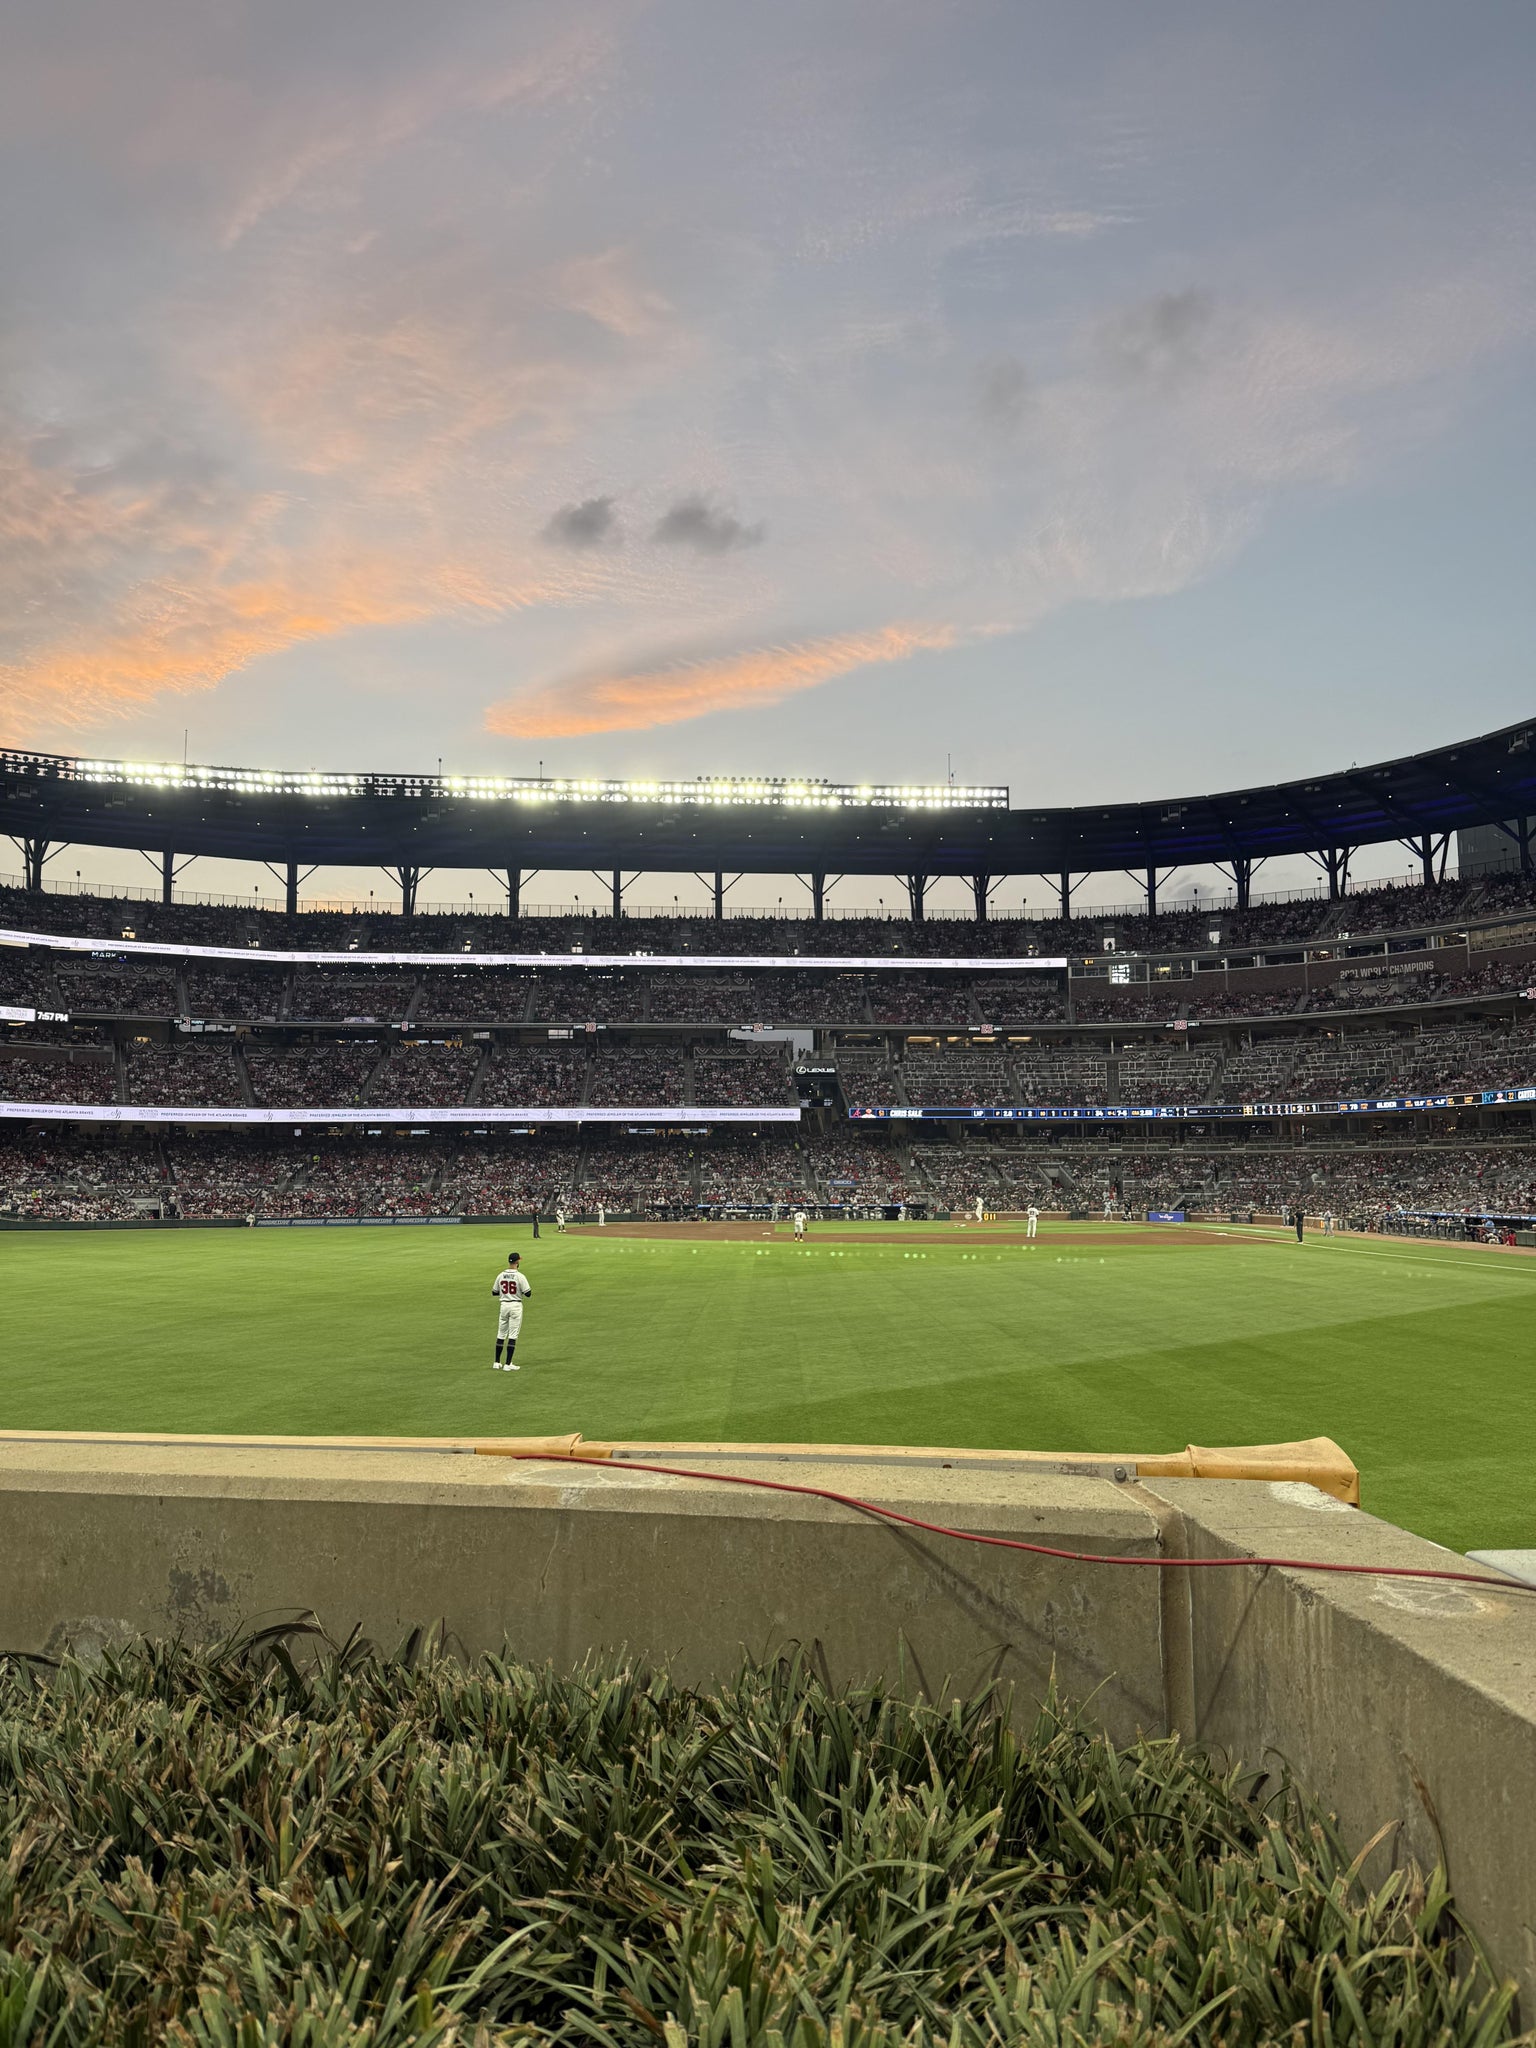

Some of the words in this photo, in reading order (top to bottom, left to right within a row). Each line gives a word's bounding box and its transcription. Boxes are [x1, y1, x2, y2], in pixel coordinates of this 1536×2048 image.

[1390, 961, 1434, 974] CHAMPIONS
[37, 1012, 54, 1020] 7:57
[55, 1013, 68, 1022] PM
[500, 1281, 516, 1294] 36
